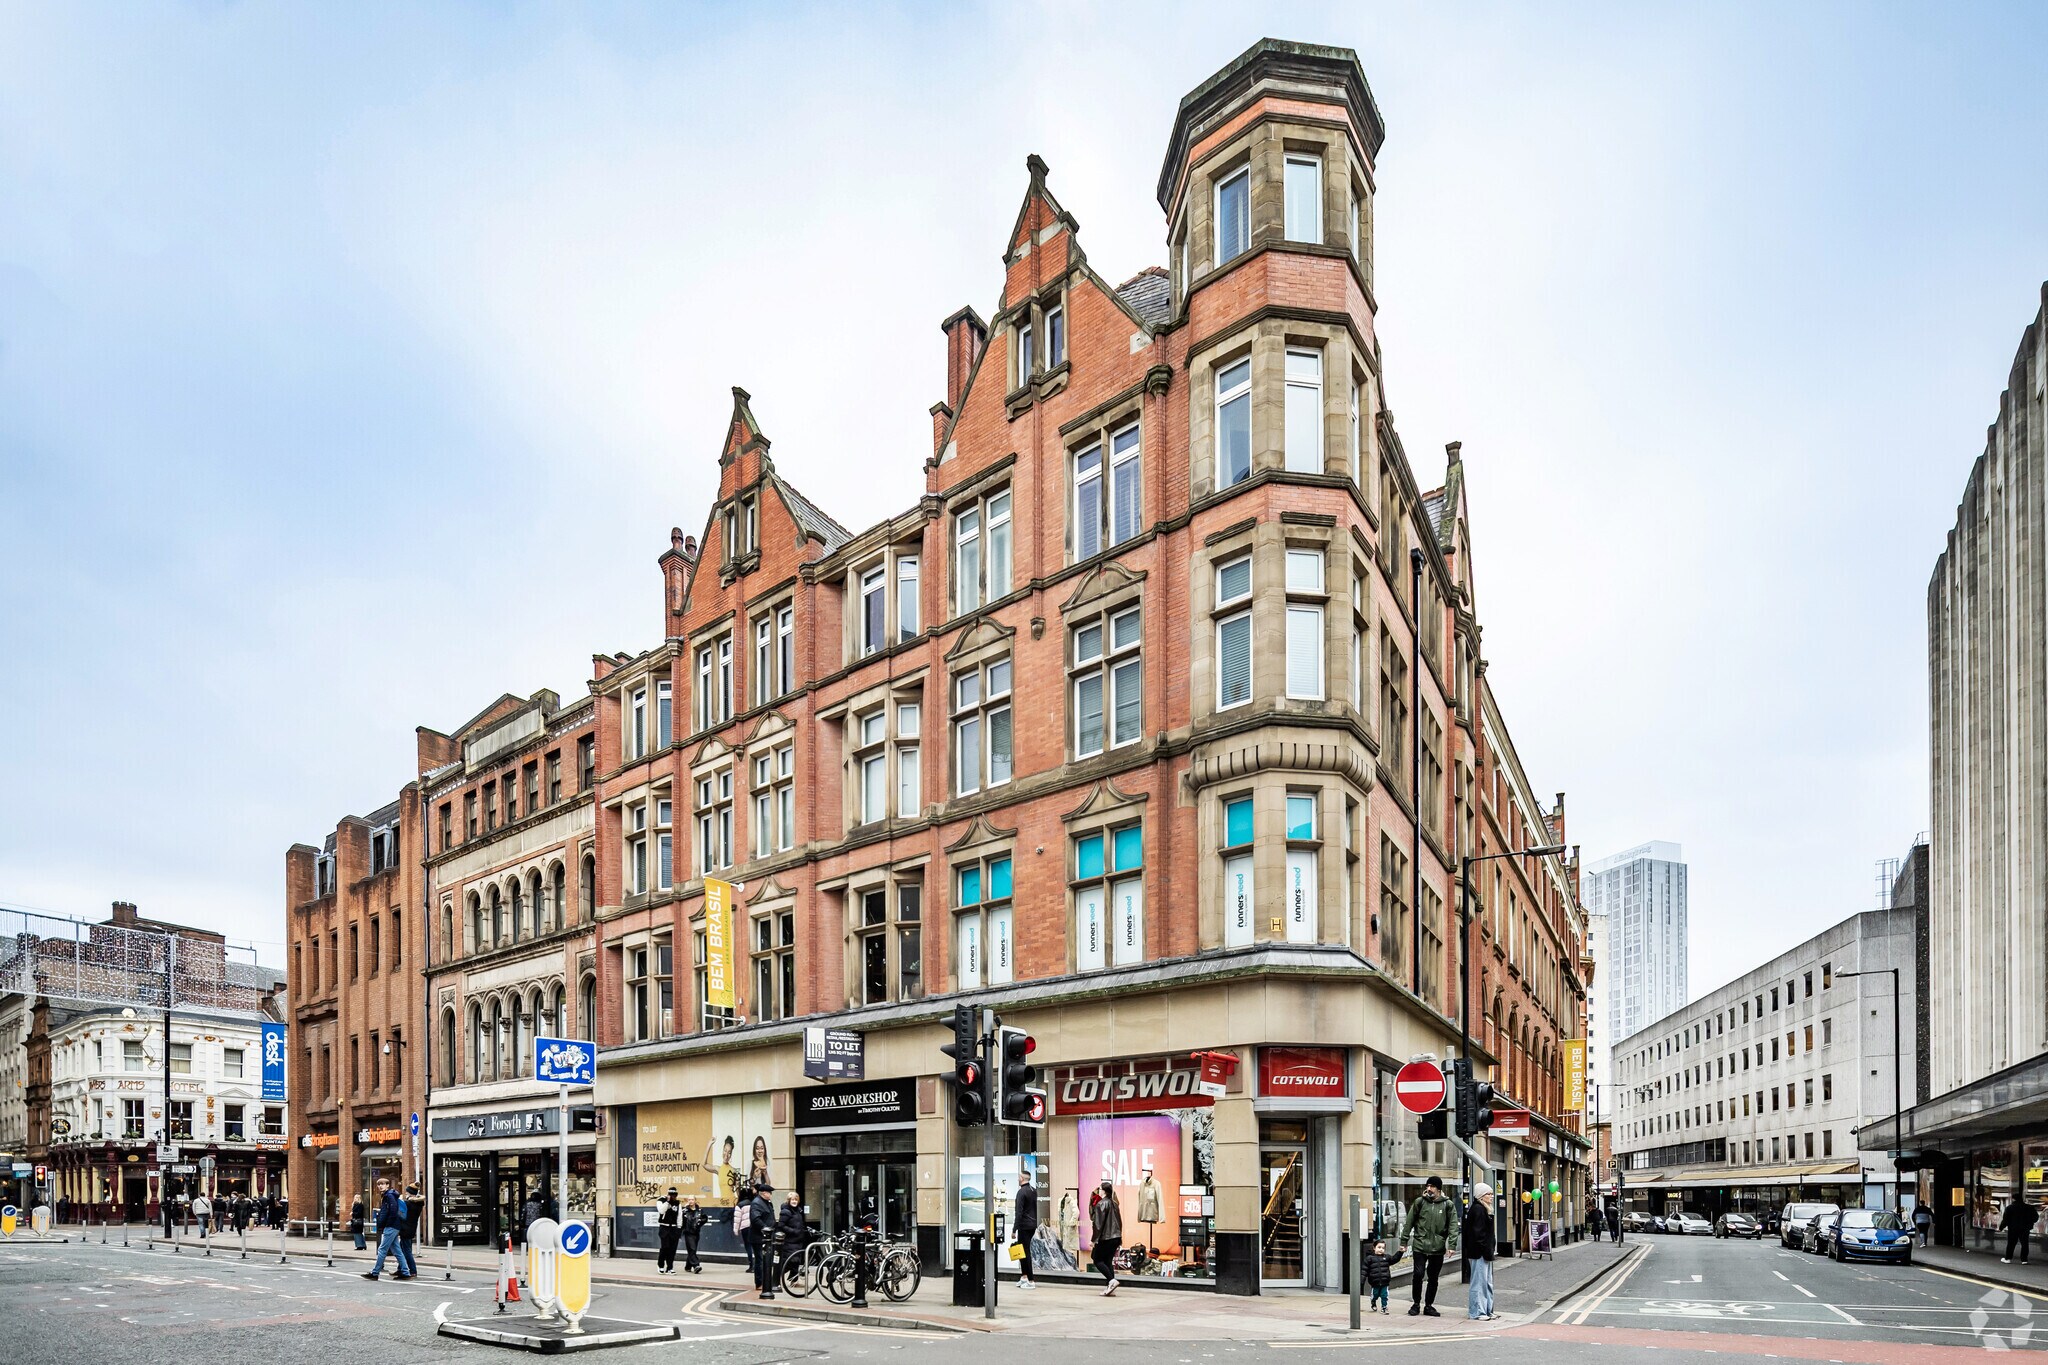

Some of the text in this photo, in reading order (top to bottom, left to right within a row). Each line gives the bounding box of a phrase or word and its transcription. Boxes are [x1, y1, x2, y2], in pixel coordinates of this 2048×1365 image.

[1236, 874, 1244, 927] runnersneed
[1293, 867, 1302, 922] runnersneed
[708, 886, 725, 990] BEM BRASIL
[266, 1031, 284, 1067] desk
[828, 1041, 860, 1051] TO LET
[1272, 1075, 1339, 1086] COTSWOLD
[1571, 1047, 1583, 1107] BEM BRASIL
[117, 1080, 146, 1092] ARMS
[1062, 1070, 1201, 1103] COTSWOL
[812, 1090, 899, 1108] SOFA WORKSHOP
[491, 1114, 522, 1134] Forsyth
[643, 1141, 684, 1151] PRIME RETAIL,
[643, 1152, 688, 1162] RESTAURANT &
[442, 1157, 481, 1172] Forsyth
[619, 1157, 635, 1186] 118
[643, 1163, 700, 1173] BAR OPPORTUNITY
[1101, 1148, 1154, 1187] SALE
[442, 1169, 448, 1177] 3
[442, 1178, 448, 1187] 2
[442, 1197, 449, 1205] G
[1184, 1200, 1202, 1214] 50%
[442, 1206, 449, 1214] B
